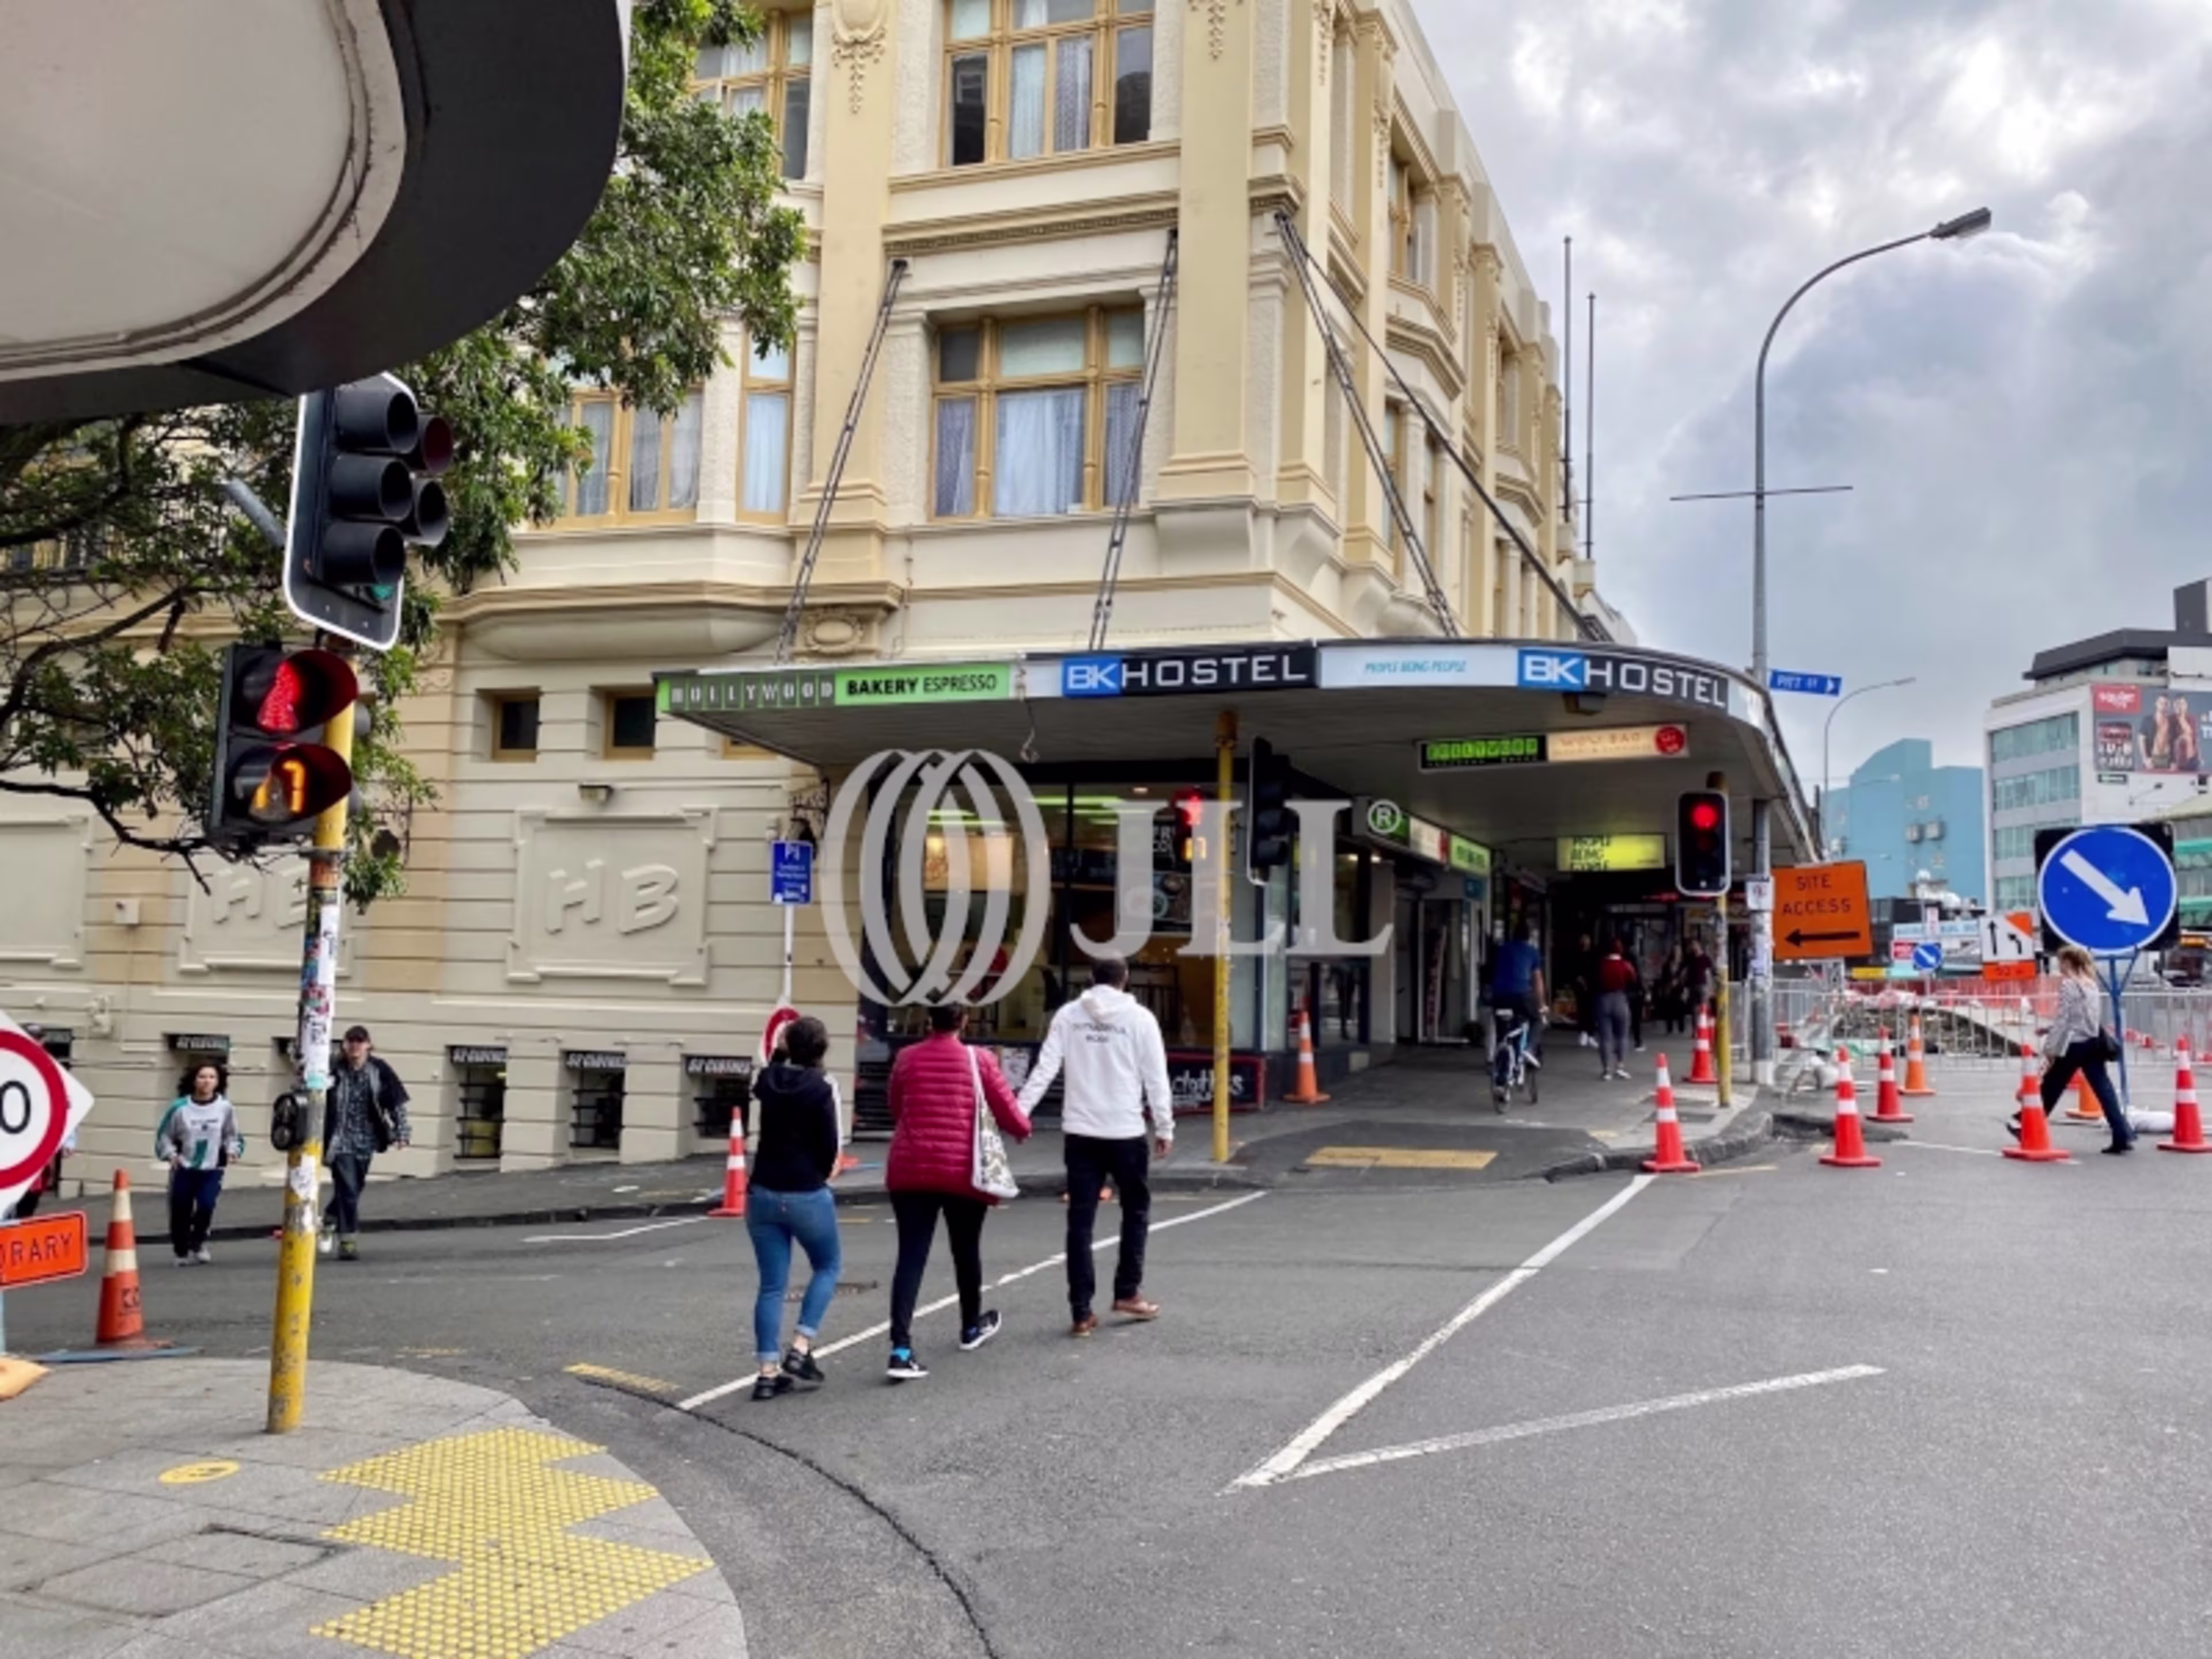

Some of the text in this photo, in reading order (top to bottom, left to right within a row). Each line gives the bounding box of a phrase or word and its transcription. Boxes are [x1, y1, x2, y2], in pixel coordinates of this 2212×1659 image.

[847, 677, 919, 696] BAKERY
[923, 672, 998, 693] ESPRESSO
[1067, 655, 1307, 690] BK HOSTEL
[1524, 655, 1726, 708] BK HOSTEL
[1796, 873, 1832, 891] SITE
[1782, 897, 1851, 916] ACCESS
